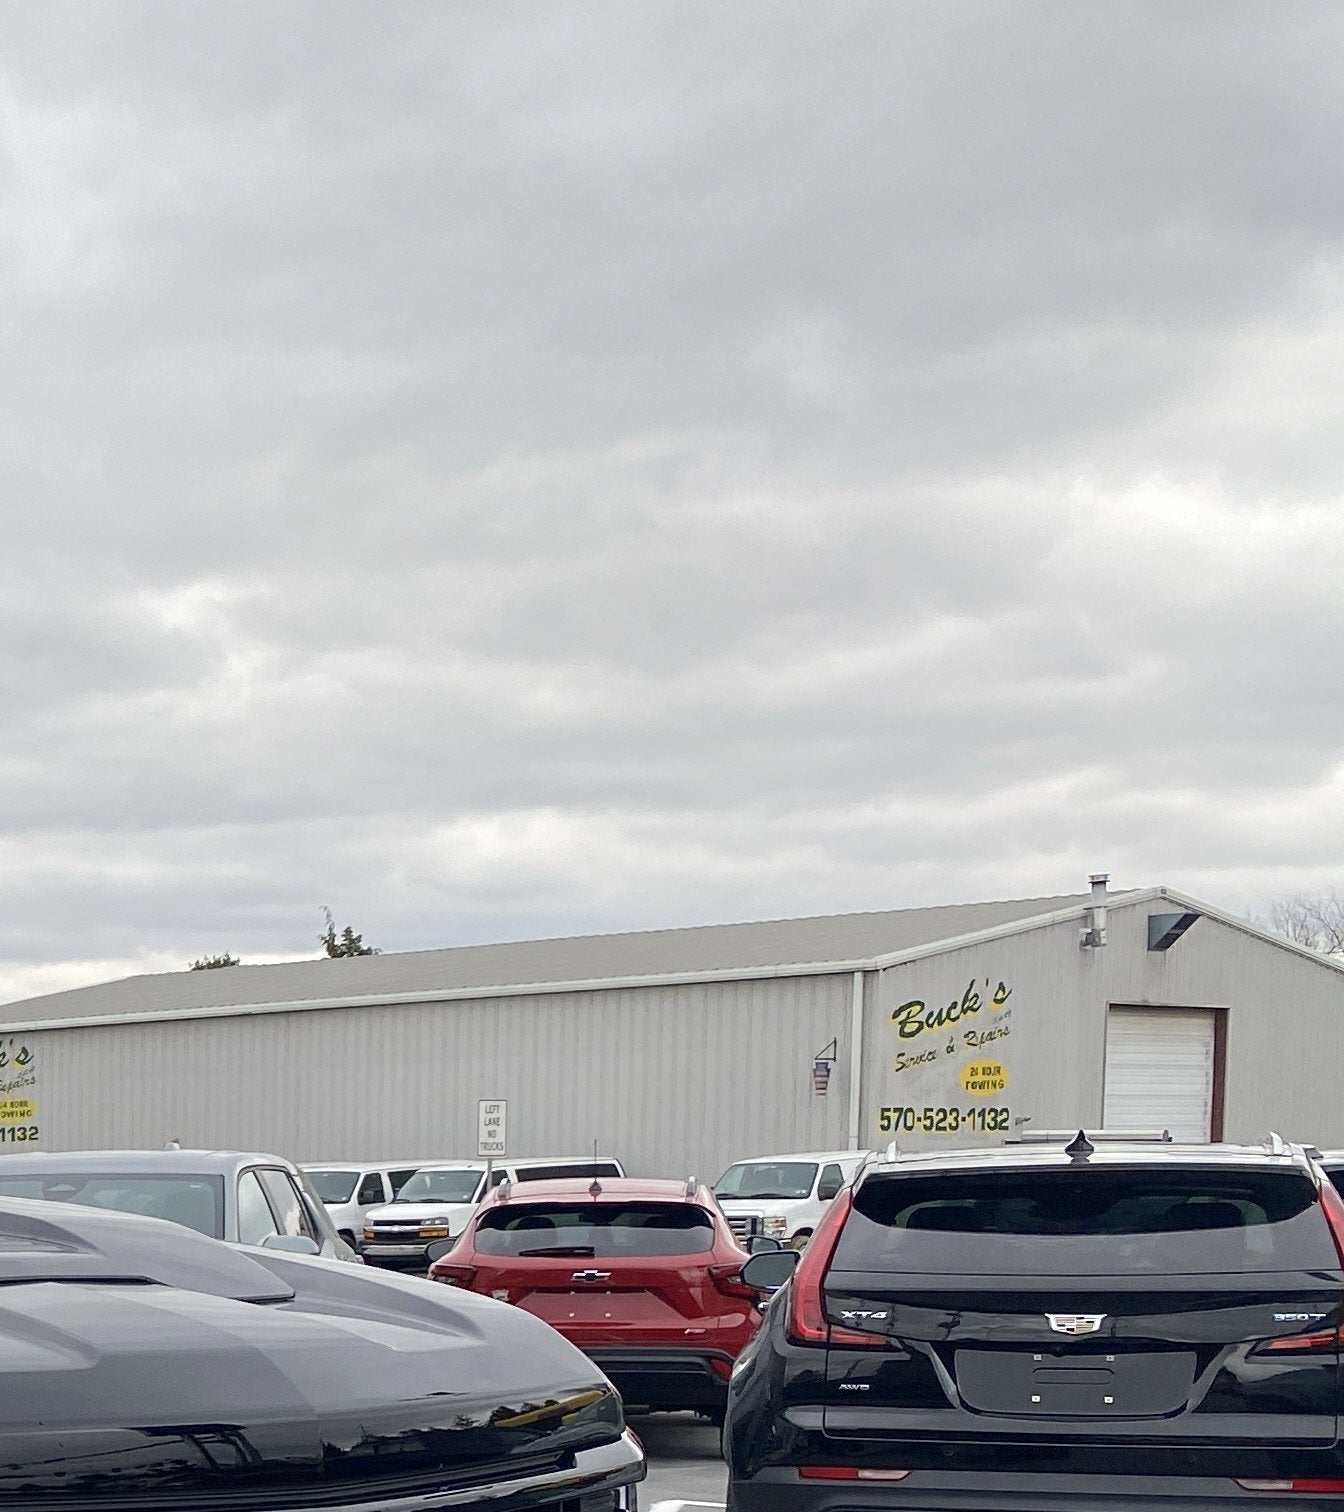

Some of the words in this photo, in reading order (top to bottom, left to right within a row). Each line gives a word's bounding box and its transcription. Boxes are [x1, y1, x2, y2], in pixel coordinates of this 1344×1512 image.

[891, 978, 1012, 1038] Buck's
[895, 1050, 937, 1073] Service
[963, 1026, 1010, 1050] Repairs
[965, 1079, 1005, 1091] TOWING
[879, 1107, 1010, 1132] 570-523-1132
[840, 1310, 888, 1319] XT4
[838, 1383, 870, 1391] AWD
